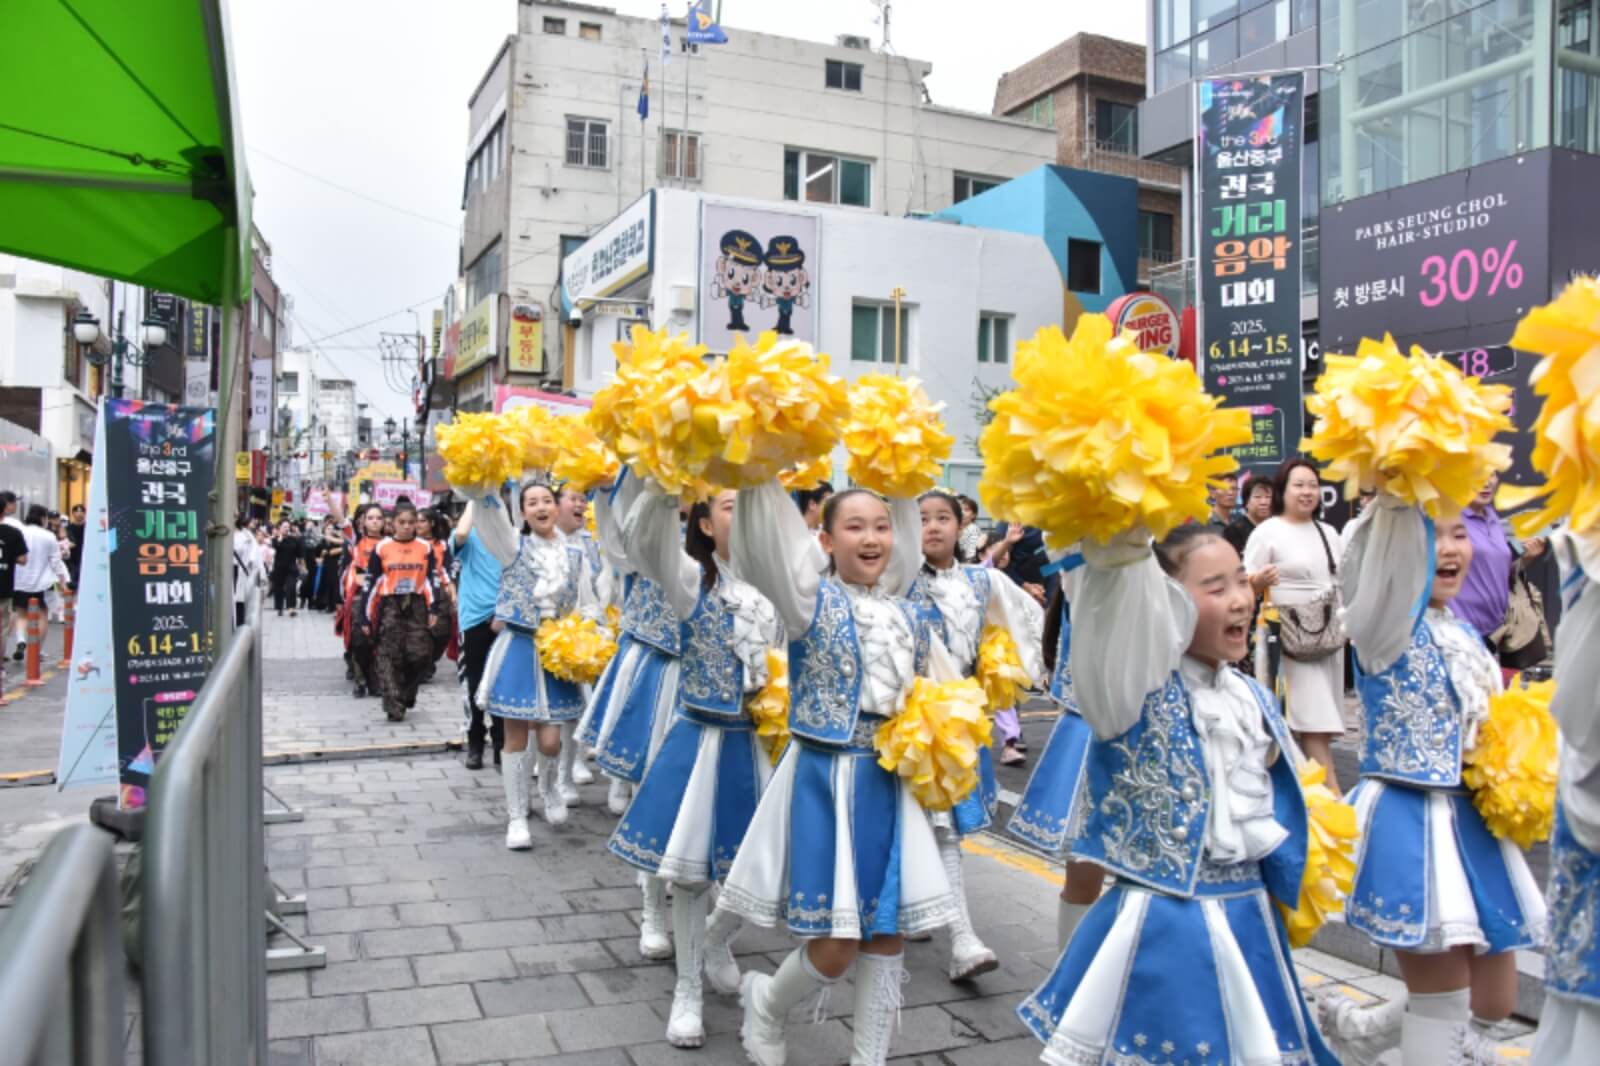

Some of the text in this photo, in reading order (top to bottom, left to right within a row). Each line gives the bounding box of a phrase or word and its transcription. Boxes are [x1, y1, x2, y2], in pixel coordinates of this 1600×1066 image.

[1216, 146, 1282, 169] 울산중구
[1219, 171, 1275, 199] 전국
[1211, 199, 1287, 237] 거리
[1355, 192, 1508, 241] PARK SEUNG CHOL
[1376, 212, 1490, 251] HAIR-STUDIO
[1212, 235, 1293, 277] 음악
[1333, 239, 1524, 308] 첫 방문시 30%
[1220, 278, 1275, 307] 대회
[1135, 326, 1172, 352] ING
[163, 440, 187, 457] 3rd
[136, 457, 192, 477] 울산중구
[141, 481, 187, 505] 전국
[135, 509, 198, 541] 거리
[136, 543, 203, 575] 음악
[145, 579, 192, 605] 대회
